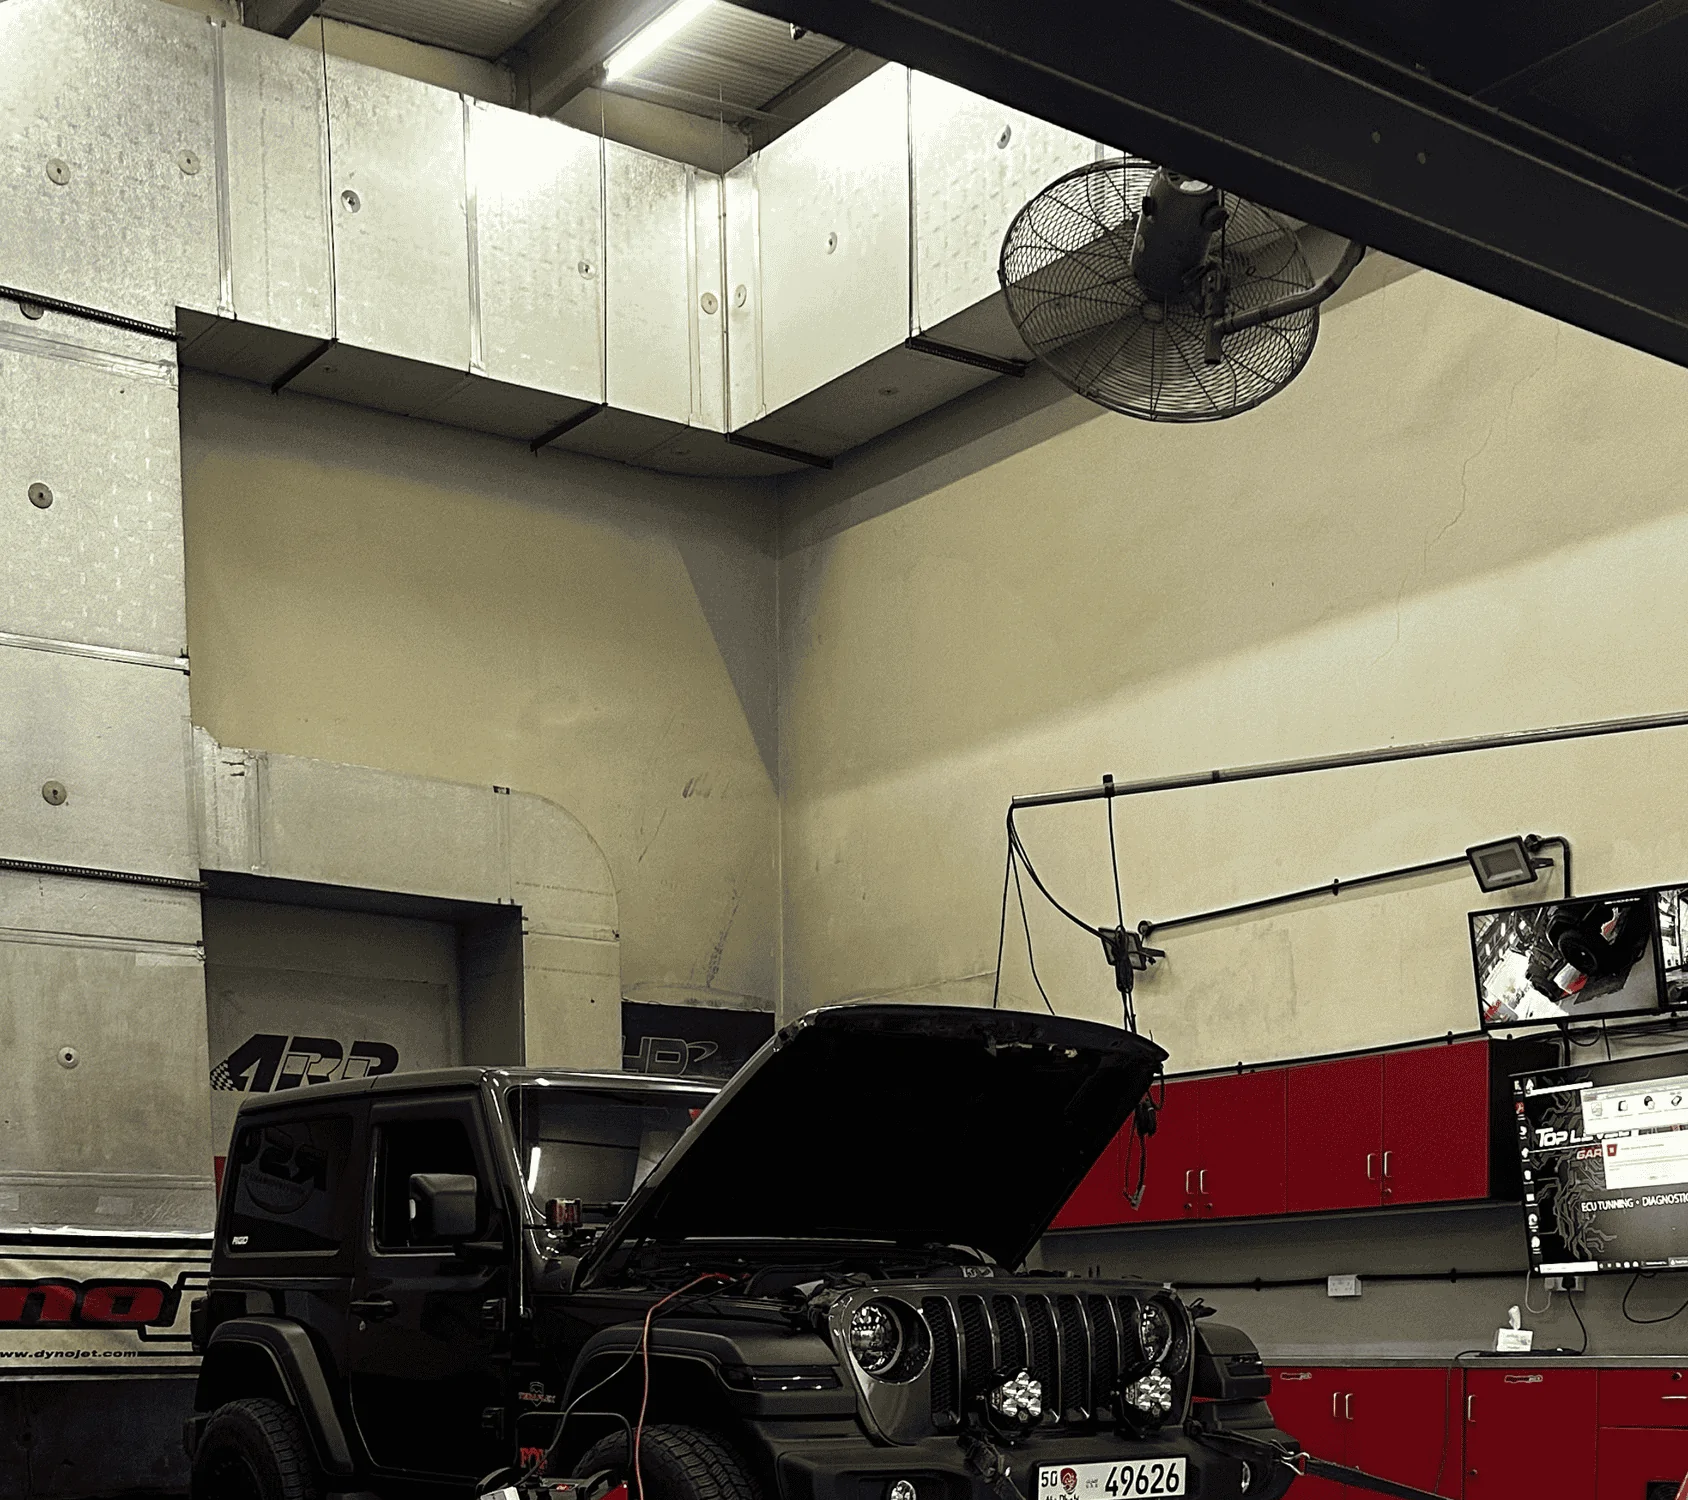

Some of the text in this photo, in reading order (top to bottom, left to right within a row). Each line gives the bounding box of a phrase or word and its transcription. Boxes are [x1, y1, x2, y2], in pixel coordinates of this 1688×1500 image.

[1581, 1201, 1597, 1212] ECU
[1041, 1471, 1058, 1487] 50
[1105, 1463, 1180, 1496] 49626
